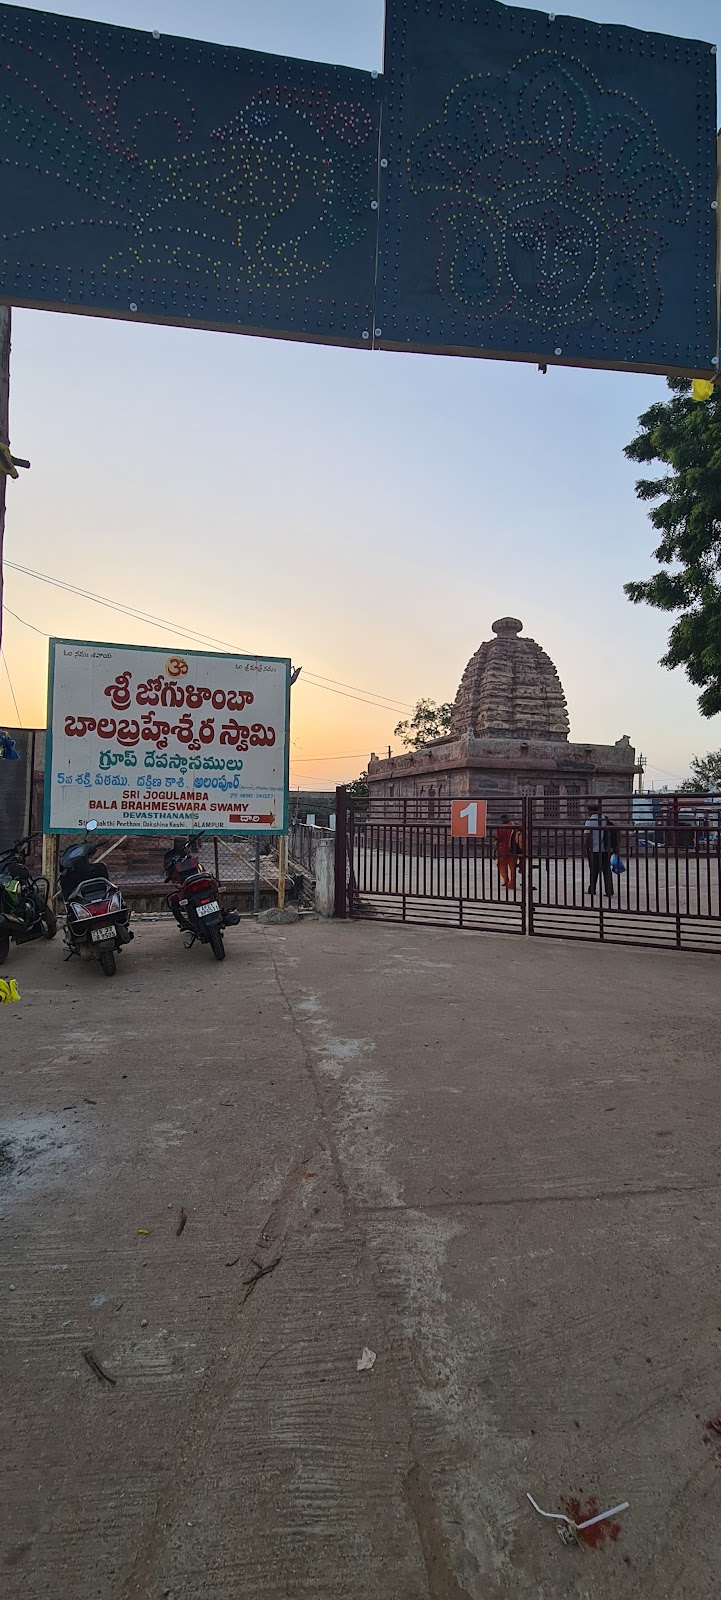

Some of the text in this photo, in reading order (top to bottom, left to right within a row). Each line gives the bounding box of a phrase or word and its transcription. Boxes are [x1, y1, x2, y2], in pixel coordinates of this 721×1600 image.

[104, 671, 132, 711] శ్రీ
[219, 719, 276, 752] స్వామి
[99, 750, 244, 775] గ్రూప్ దేవస్థానములు
[75, 772, 92, 788] శక్తి
[137, 775, 161, 789] దక్షిణ
[193, 774, 240, 791] అలంపూర్
[89, 800, 249, 812] BALA BRAHMESWARA SWAMY
[122, 790, 209, 801] SRI JOGULAMBA
[123, 812, 199, 820] DEVASTHANAMS
[460, 803, 477, 834] 1
